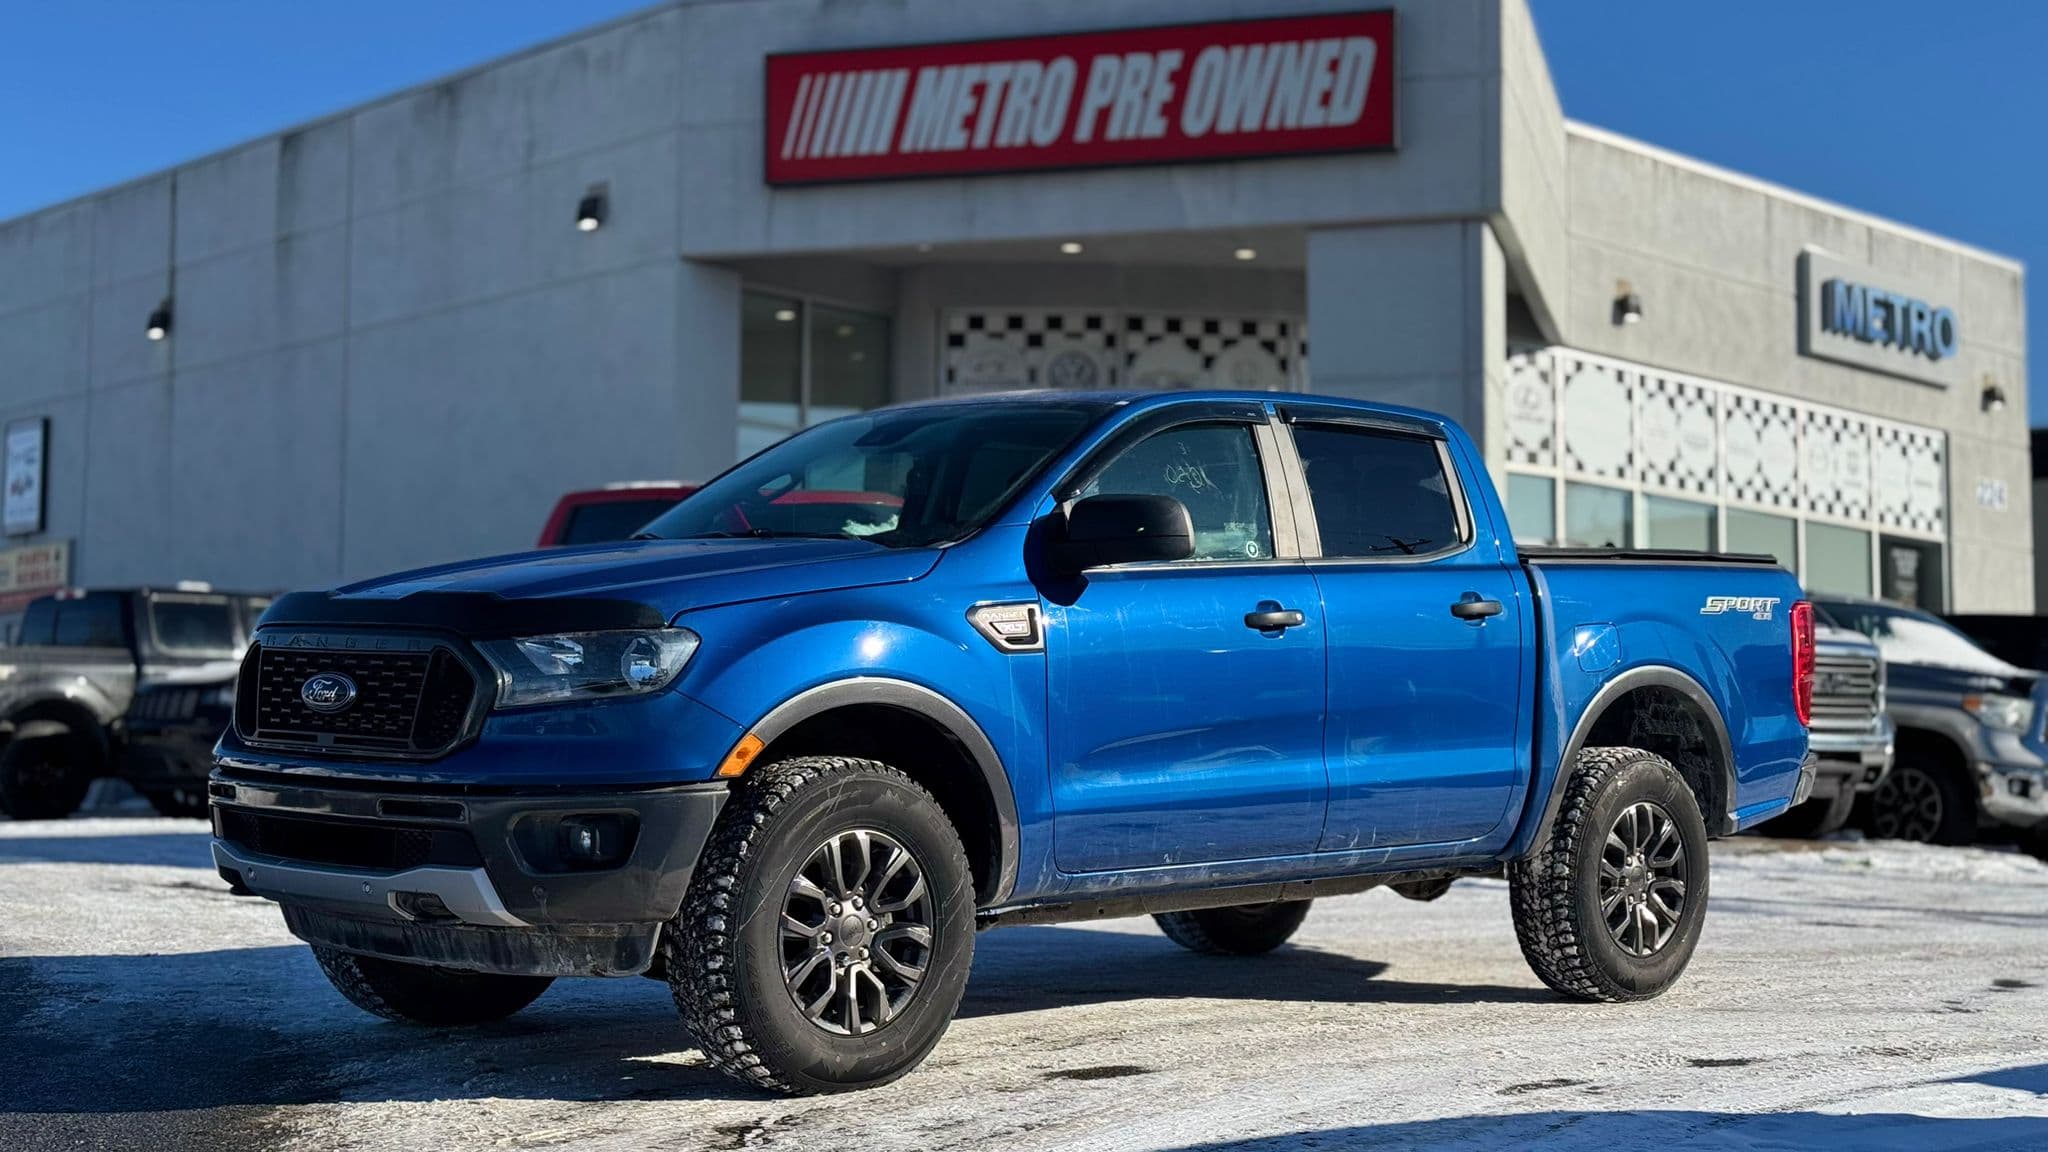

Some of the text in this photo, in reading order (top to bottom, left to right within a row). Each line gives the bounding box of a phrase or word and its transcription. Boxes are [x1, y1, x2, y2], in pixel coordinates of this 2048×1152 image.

[899, 37, 1377, 153] METRO PRE OWNED
[1828, 279, 1958, 357] METRO
[1700, 596, 1780, 614] SPORT
[265, 634, 422, 650] RANGER
[308, 679, 339, 701] Ford
